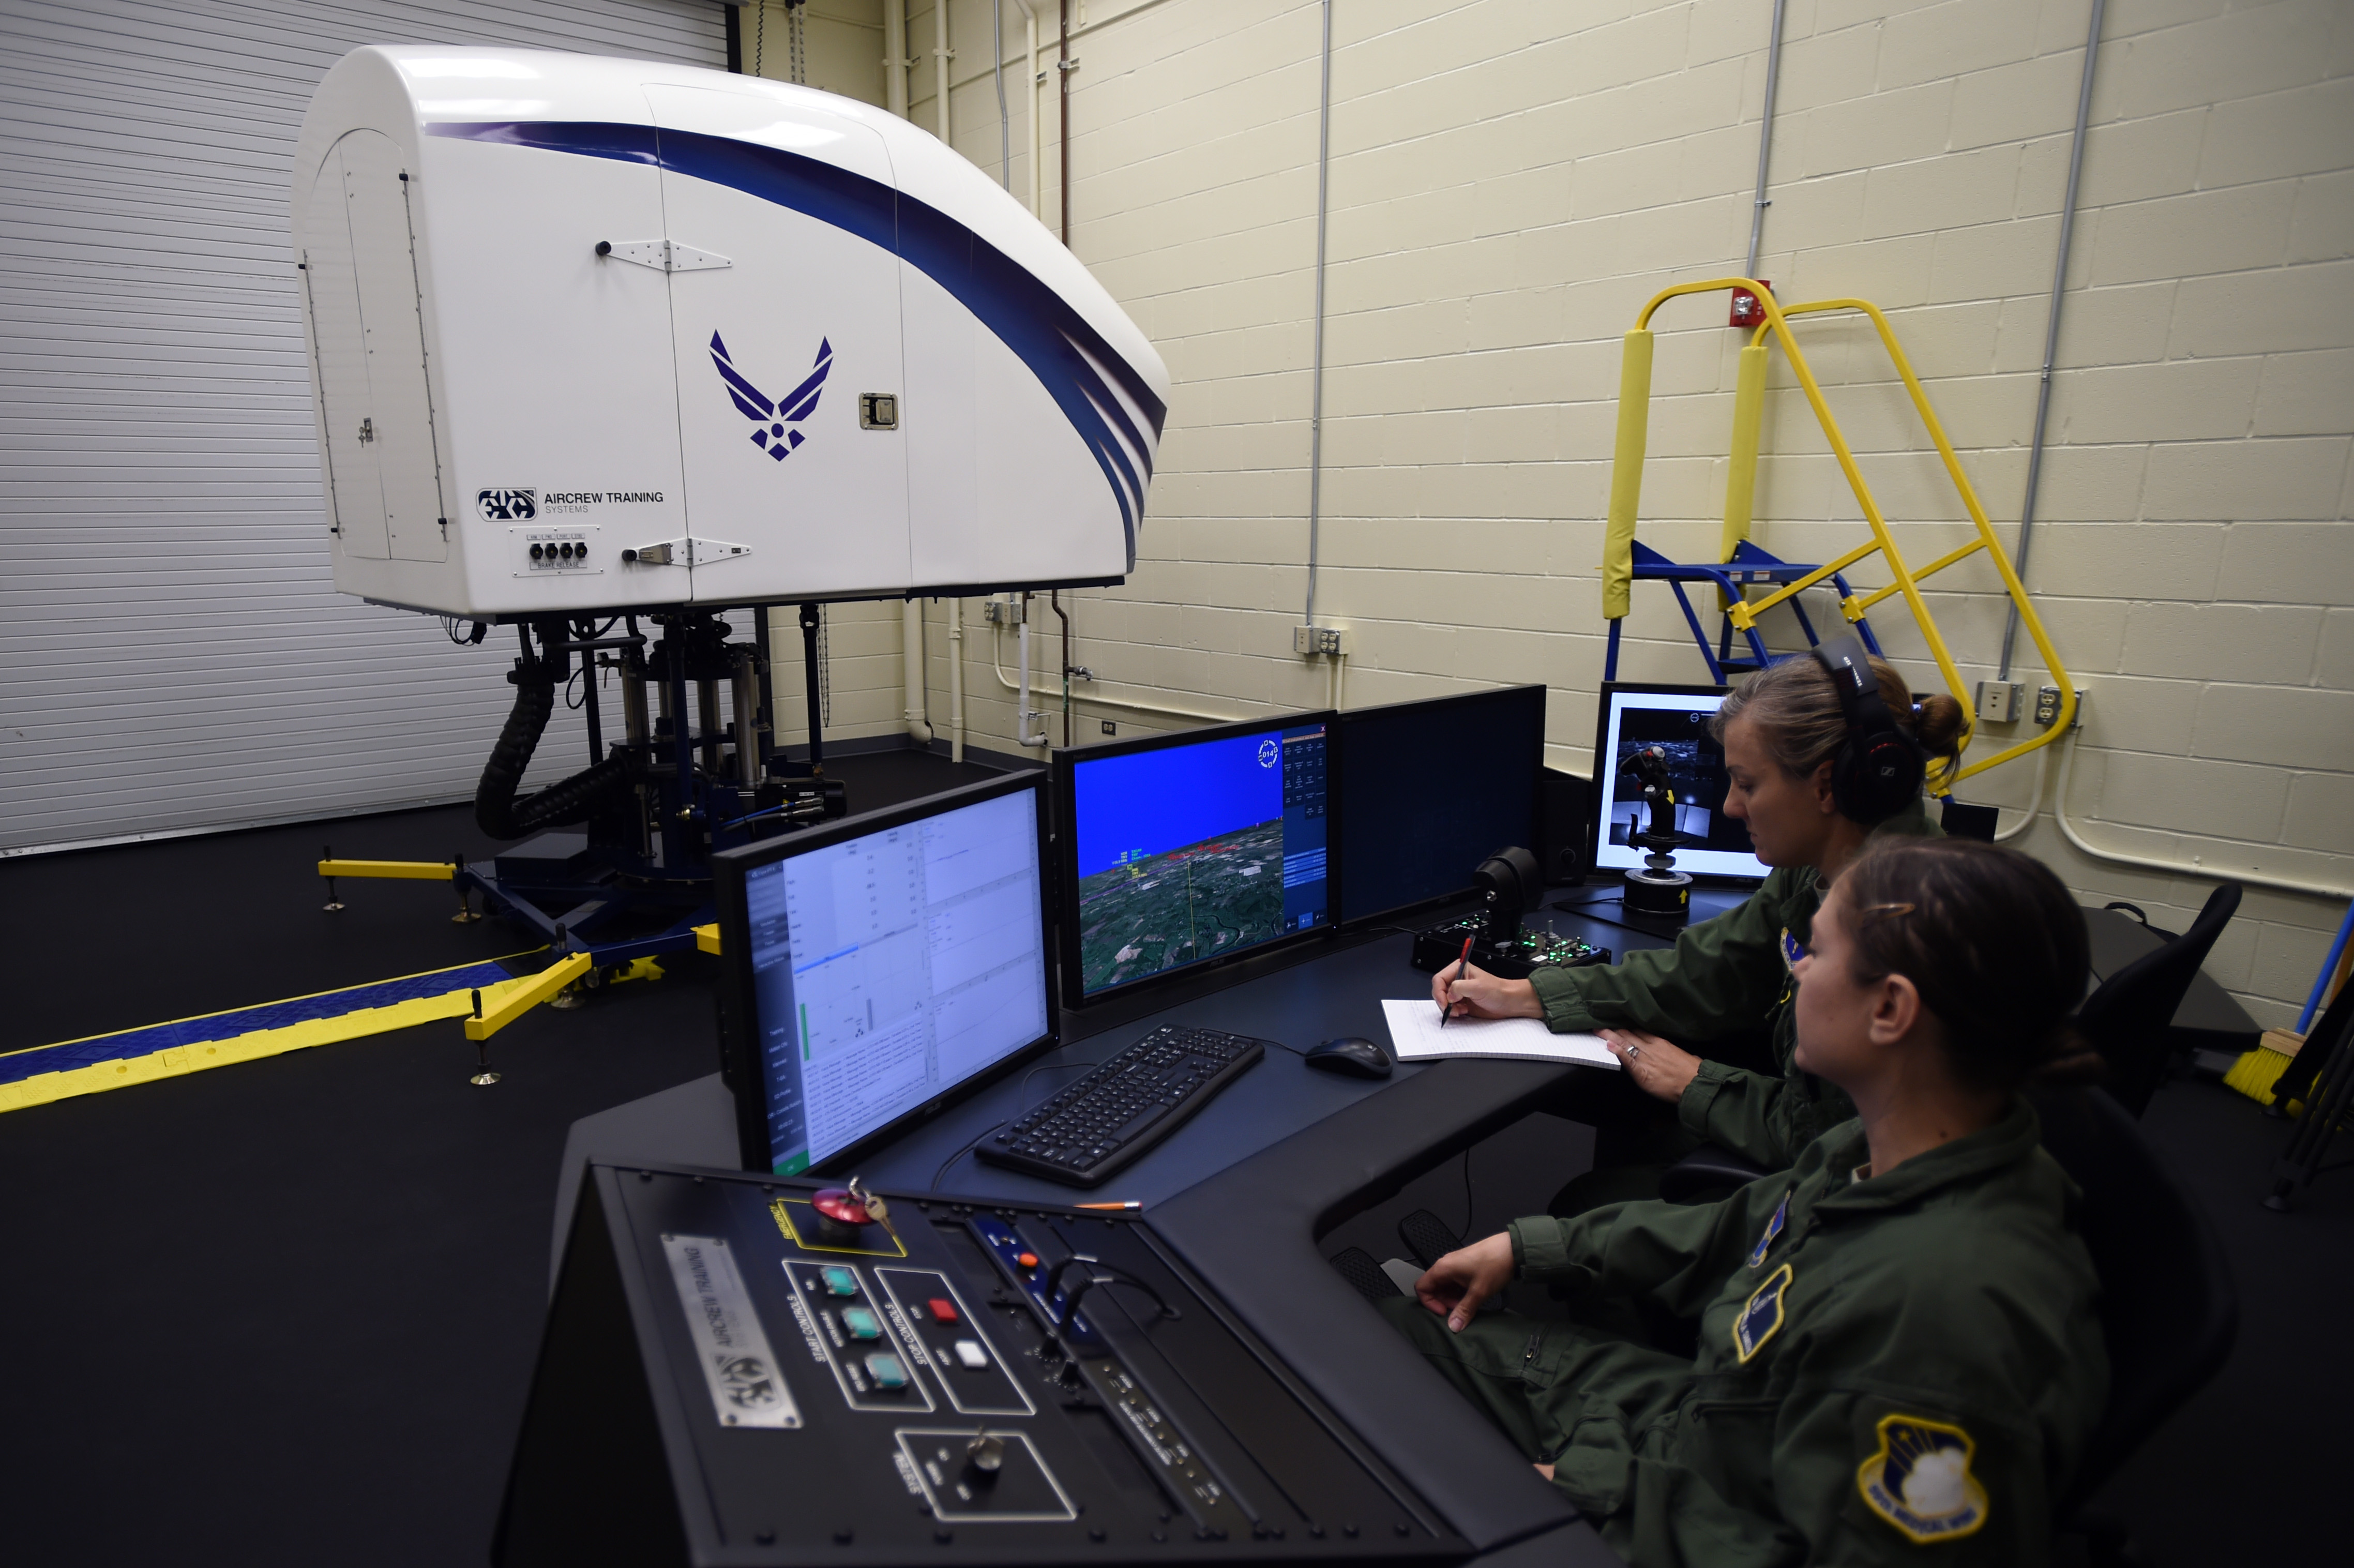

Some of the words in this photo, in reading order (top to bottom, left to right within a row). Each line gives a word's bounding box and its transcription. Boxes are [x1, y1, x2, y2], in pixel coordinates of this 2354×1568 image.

[544, 493, 602, 504] AIRCREW
[606, 492, 664, 503] TRAINING
[545, 505, 588, 514] SYSTEMS
[684, 1247, 713, 1293] TRAINING
[701, 1296, 733, 1348] AIRCREW
[787, 1294, 814, 1336] CONTROLS
[885, 1303, 914, 1344] CONTROLS
[805, 1336, 827, 1363] START
[908, 1343, 927, 1366] STOP
